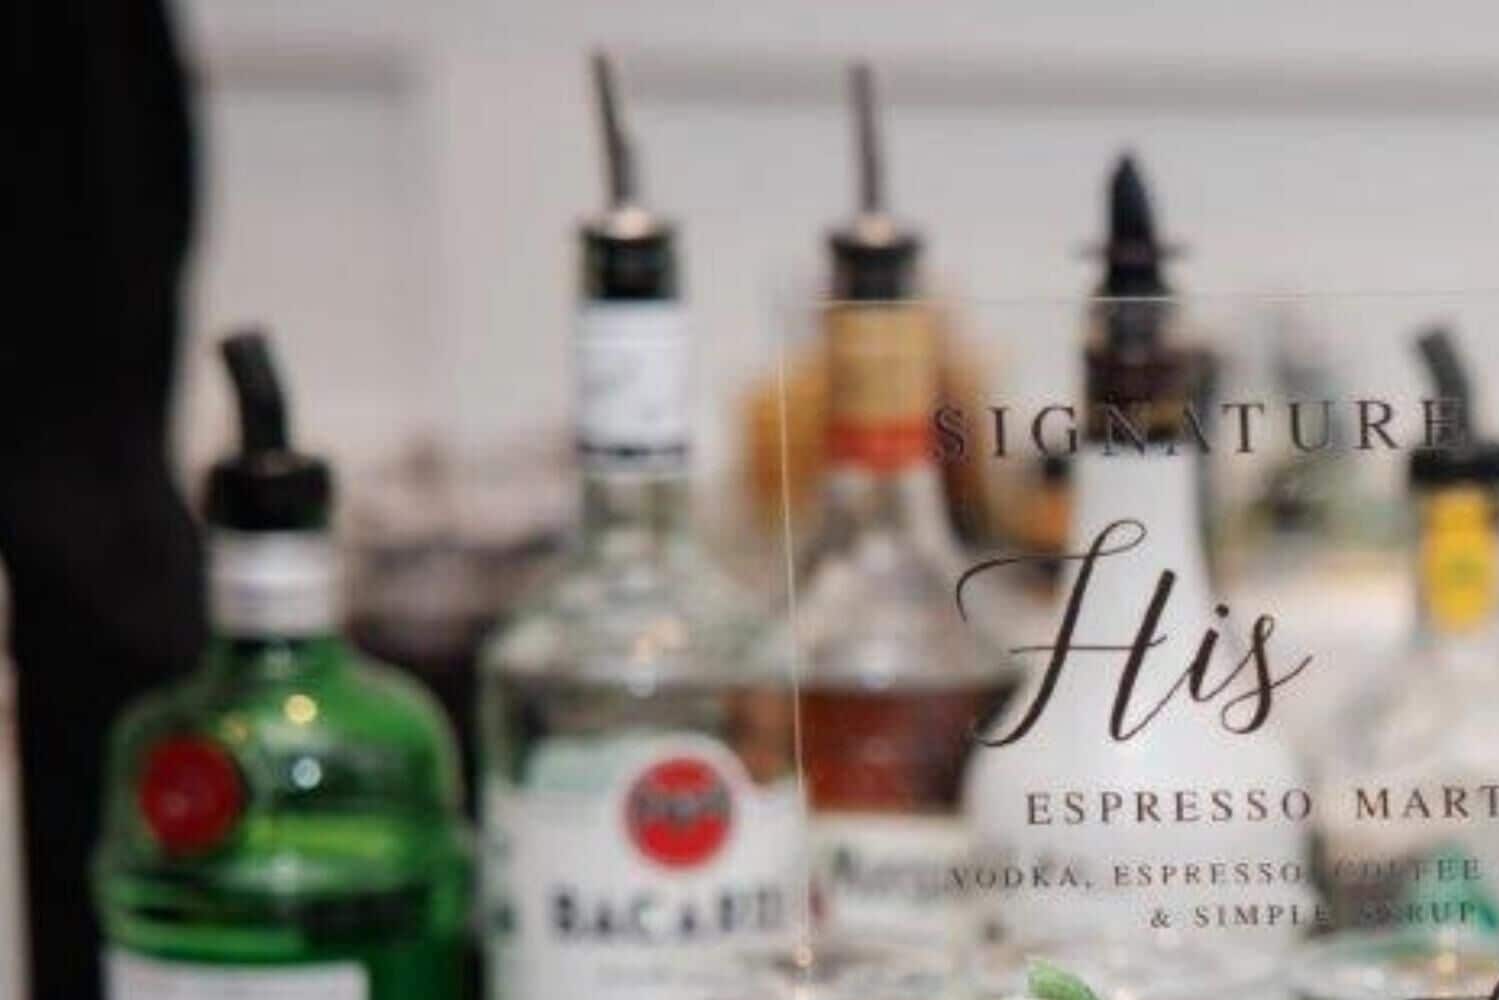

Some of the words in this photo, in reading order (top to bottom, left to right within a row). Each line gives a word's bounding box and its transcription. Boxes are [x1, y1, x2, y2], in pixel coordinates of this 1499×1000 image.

[934, 400, 1460, 460] SIGNATURE
[956, 518, 1314, 748] His
[1025, 786, 1314, 826] ESPRESSO
[947, 862, 1094, 891] VODKA,
[1150, 907, 1170, 929] &
[1194, 903, 1331, 927] SIMPLE
